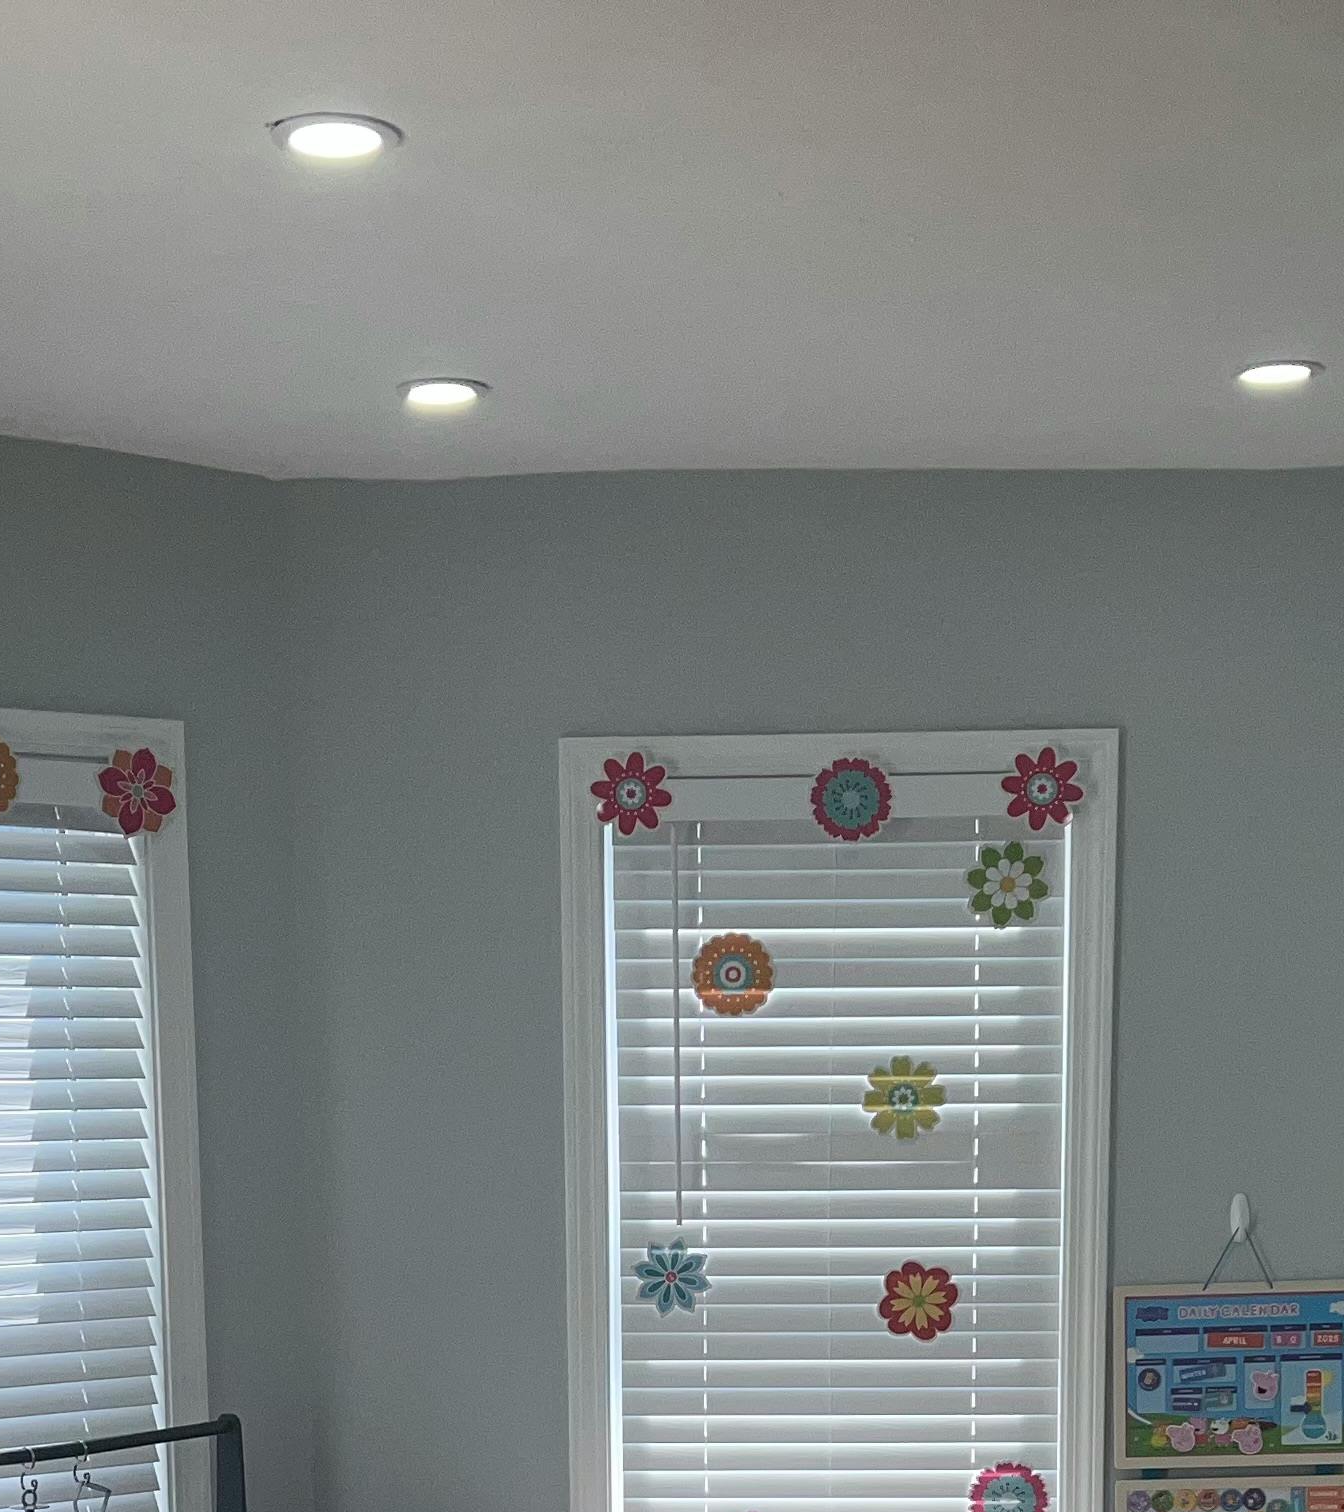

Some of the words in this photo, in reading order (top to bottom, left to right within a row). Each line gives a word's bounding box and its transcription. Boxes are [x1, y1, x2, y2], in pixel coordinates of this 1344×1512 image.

[1179, 1305, 1217, 1319] DAILY
[1221, 1302, 1299, 1317] CALENDAR
[1222, 1335, 1247, 1345] APRIL
